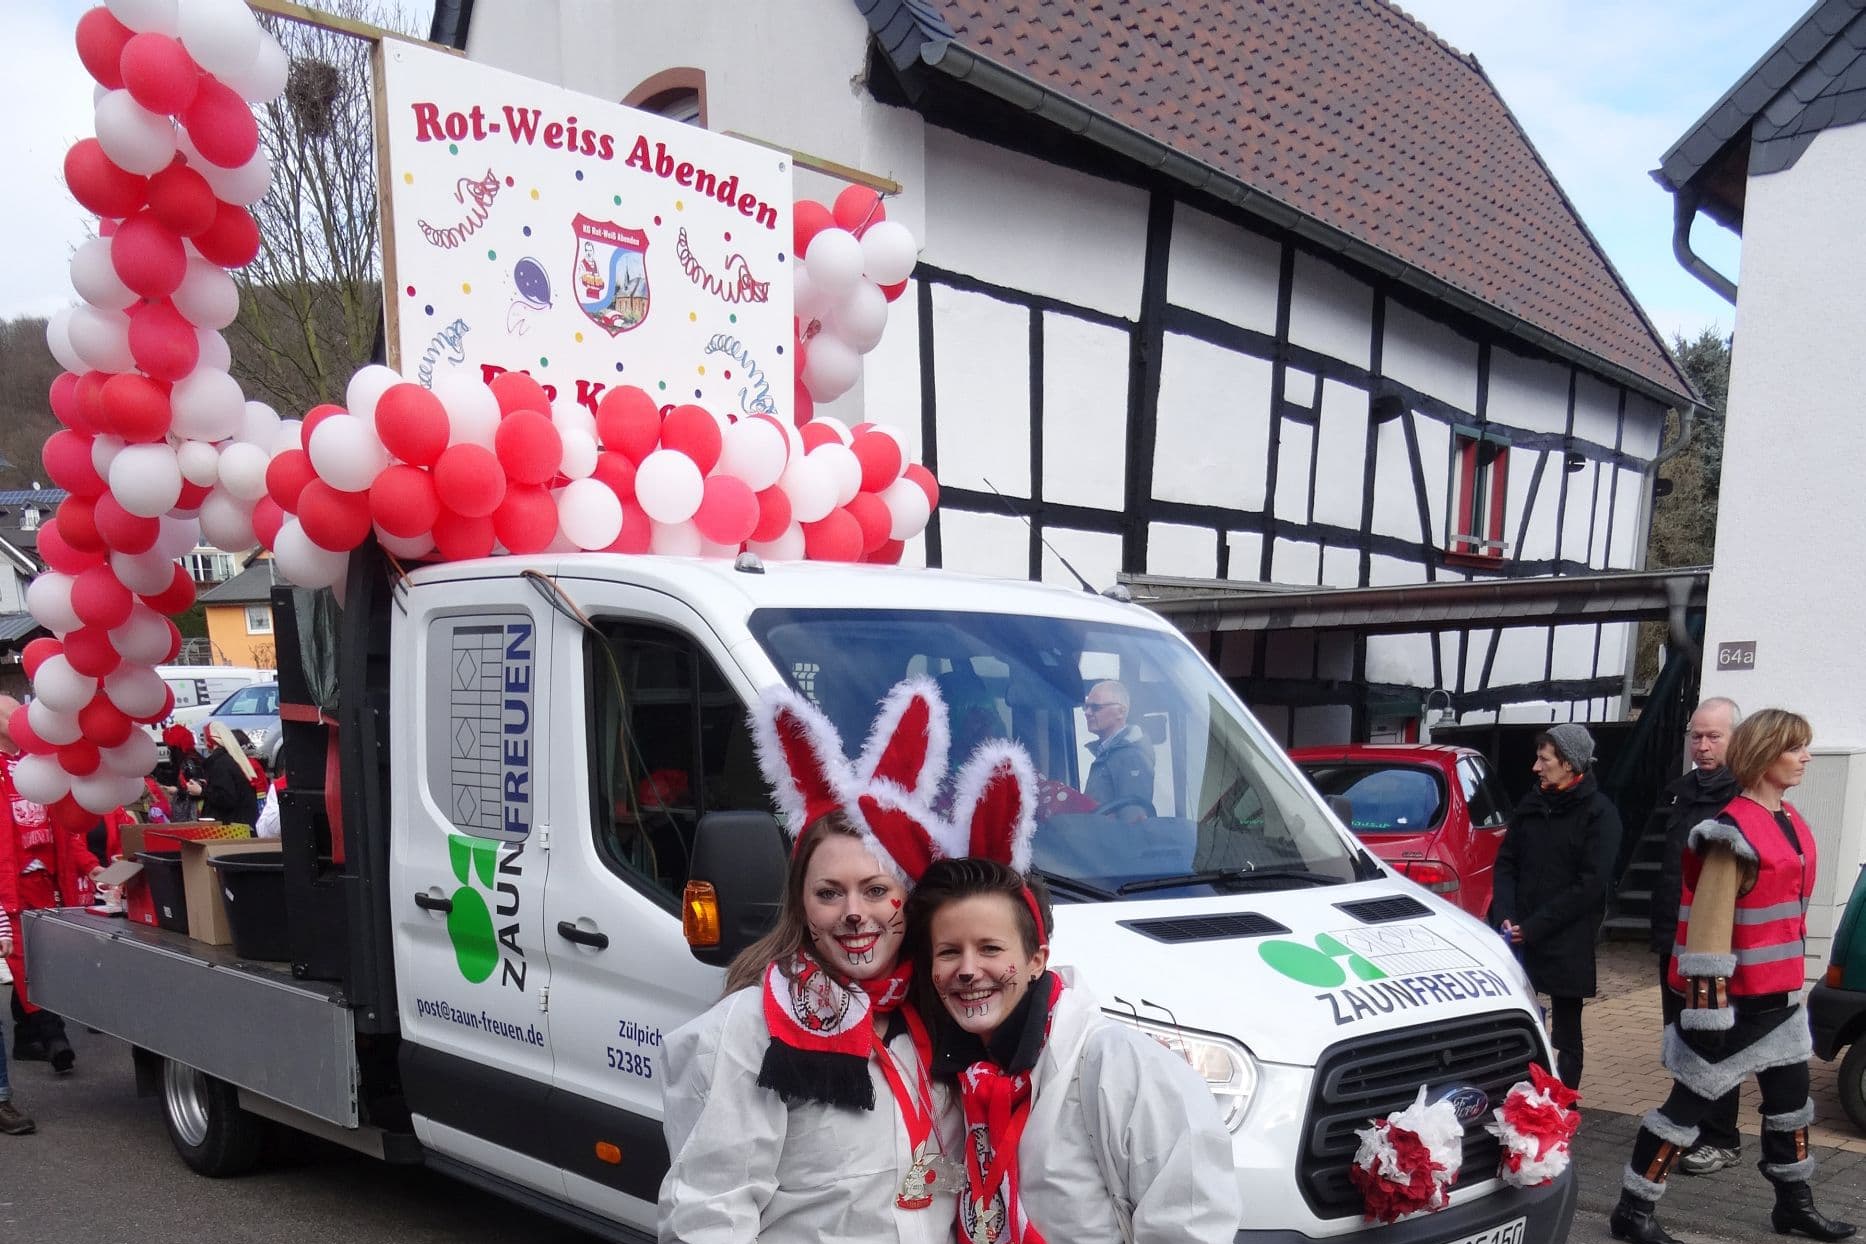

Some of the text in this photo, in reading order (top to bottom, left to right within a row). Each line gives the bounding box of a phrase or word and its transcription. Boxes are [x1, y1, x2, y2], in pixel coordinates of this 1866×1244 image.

[411, 102, 778, 230] Rot-Weiss Abenden
[1719, 648, 1754, 665] 64a
[1315, 968, 1513, 1026] ZAUNFREUEN
[416, 997, 545, 1047] post@zaun-freuen.de
[607, 1046, 653, 1079] 52385
[1453, 1095, 1481, 1118] Ford
